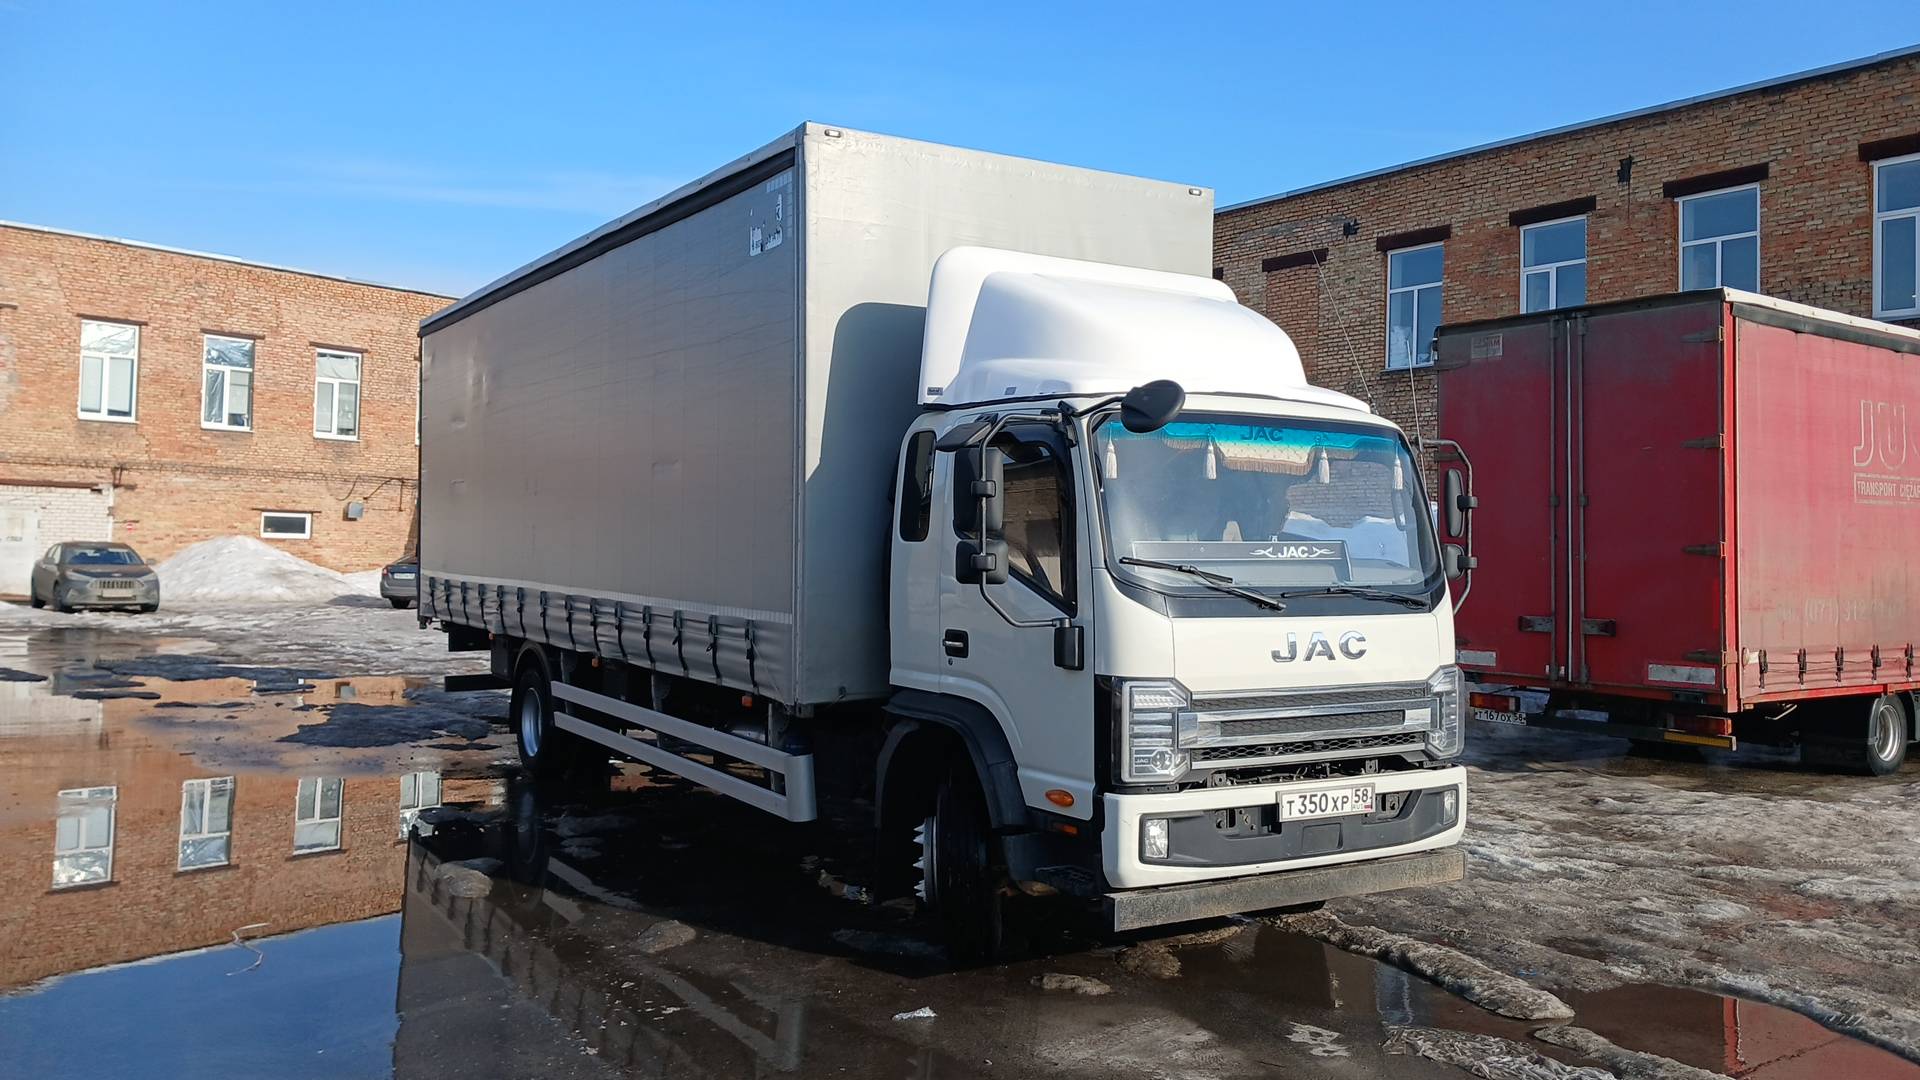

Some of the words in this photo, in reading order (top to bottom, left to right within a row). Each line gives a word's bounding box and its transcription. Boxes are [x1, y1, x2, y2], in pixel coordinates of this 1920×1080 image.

[1241, 425, 1284, 442] JAC
[1857, 480, 1897, 497] TRANSPORT
[1278, 545, 1309, 558] JAC
[1271, 630, 1367, 663] JAC
[1354, 788, 1369, 803] 58
